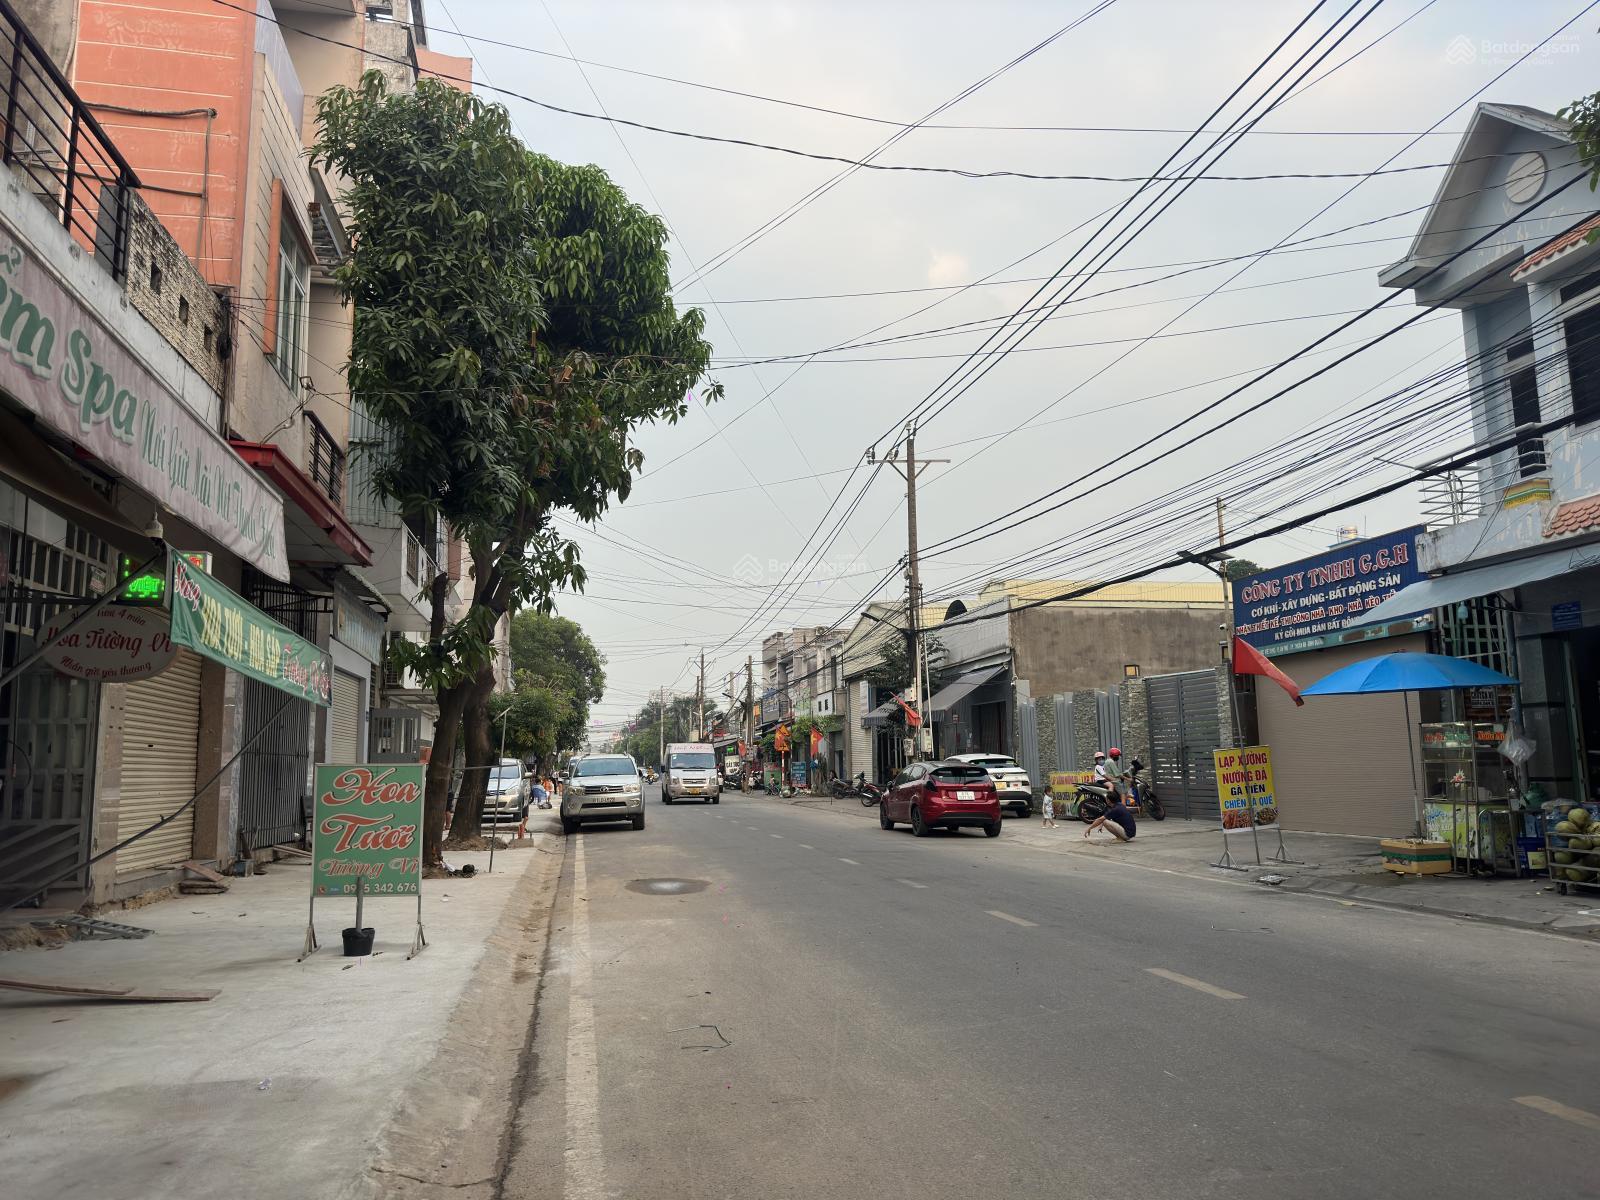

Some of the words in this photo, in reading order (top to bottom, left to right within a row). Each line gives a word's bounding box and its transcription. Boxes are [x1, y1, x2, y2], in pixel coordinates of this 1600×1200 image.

[61, 329, 136, 445] Spa
[1242, 579, 1281, 604] CÔNG
[1283, 571, 1305, 594] TY
[1307, 557, 1356, 588] TNHH
[1251, 606, 1263, 618] CƠ
[1348, 579, 1377, 597] ĐỘNG
[1378, 572, 1401, 588] SẢN
[118, 608, 127, 618] 4
[1292, 611, 1311, 625] CÔNG
[1310, 607, 1326, 620] NHÀ
[1328, 604, 1344, 617] KHO
[1347, 597, 1364, 613] NHÀ
[1364, 593, 1381, 610] KÈO
[201, 593, 222, 651] HOA
[249, 623, 265, 673] HOA
[265, 627, 281, 678] SÁP
[1311, 621, 1327, 633] BÁN
[1327, 618, 1340, 630] BẤT
[86, 627, 144, 659] Tường
[148, 632, 173, 653] Vi
[1218, 755, 1235, 770] LẠP
[321, 767, 421, 806] Hoa
[1222, 769, 1253, 785] NƯỚNG
[1255, 767, 1268, 781] ĐÁ
[1230, 784, 1243, 796] GÀ
[1224, 797, 1247, 810] CHIÊN
[320, 813, 416, 854] Tươi
[388, 857, 419, 875] Vi
[343, 883, 370, 893] 095
[374, 883, 394, 893] 342
[397, 882, 417, 892] 676
